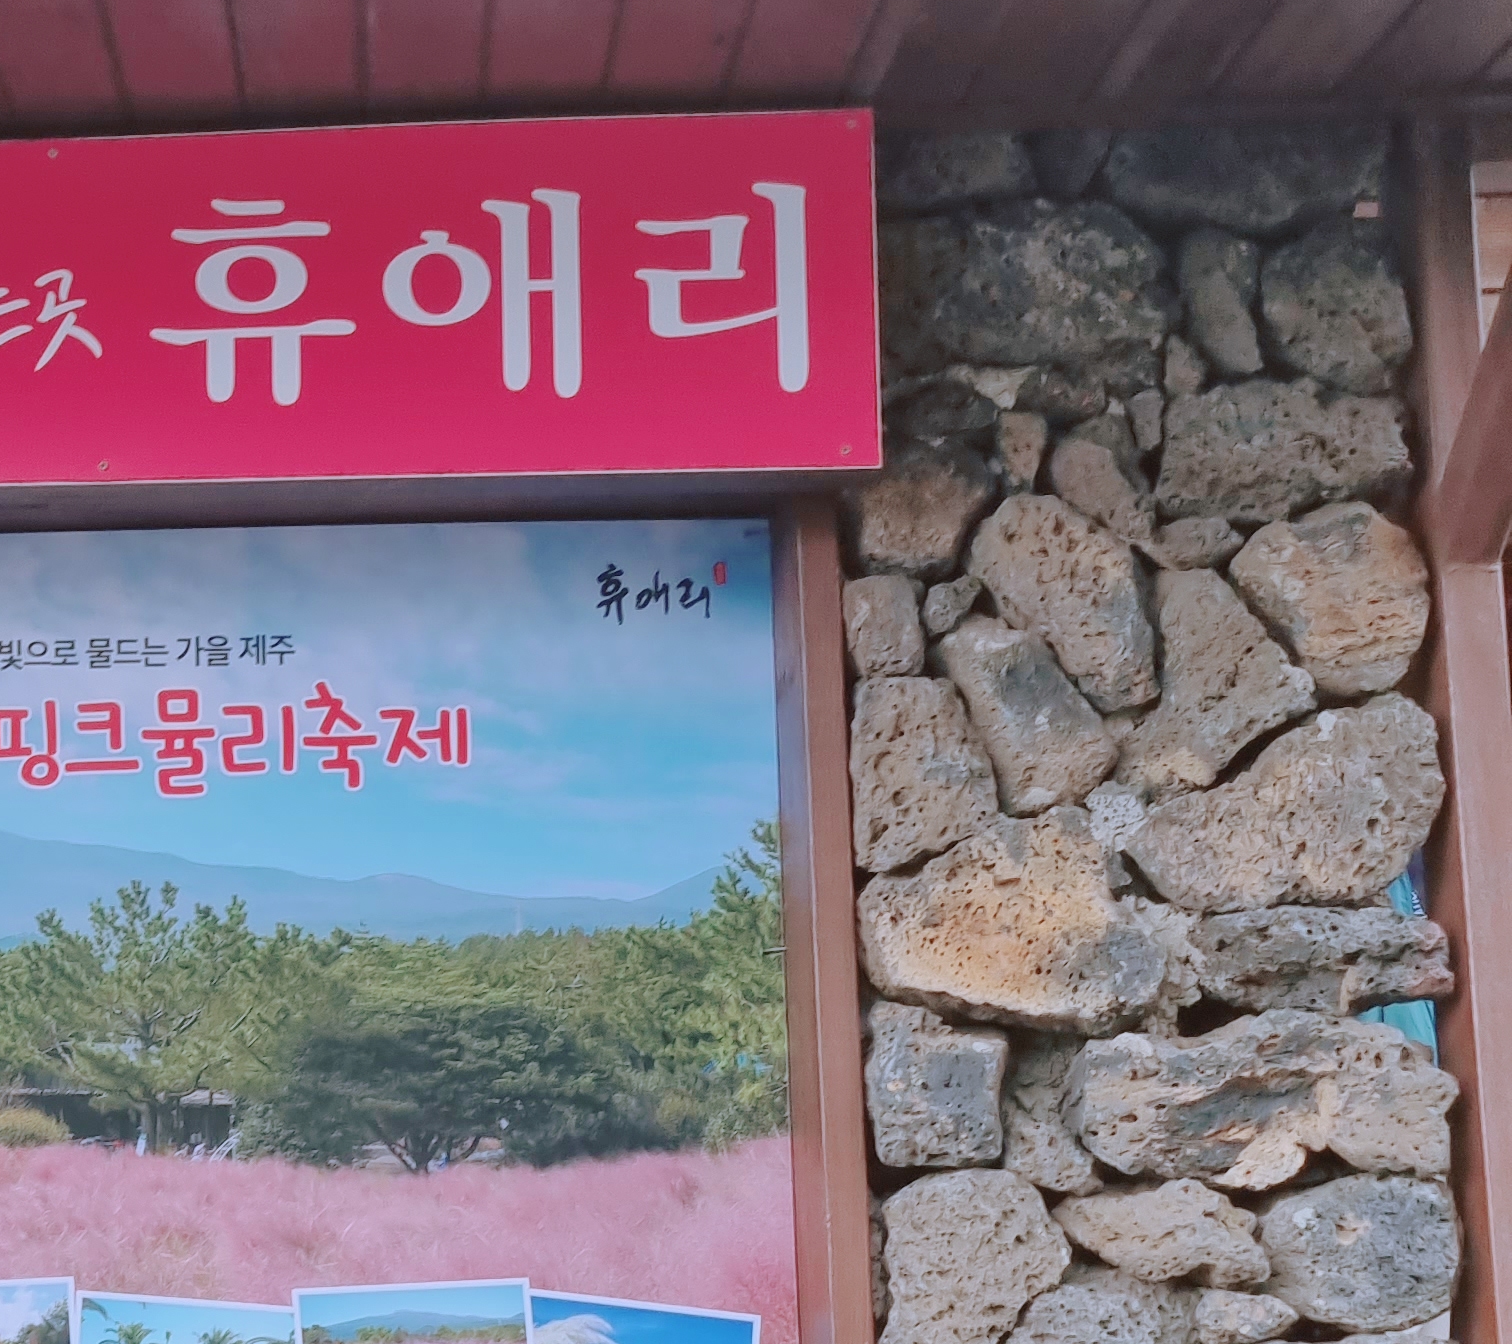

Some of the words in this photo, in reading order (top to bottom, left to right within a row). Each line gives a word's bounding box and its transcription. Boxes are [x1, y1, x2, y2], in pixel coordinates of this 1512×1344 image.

[149, 182, 810, 406] 휴애리
[596, 563, 711, 626] 휴애리
[85, 637, 170, 669] 물드는
[176, 635, 232, 667] 가을
[239, 633, 296, 666] 제주
